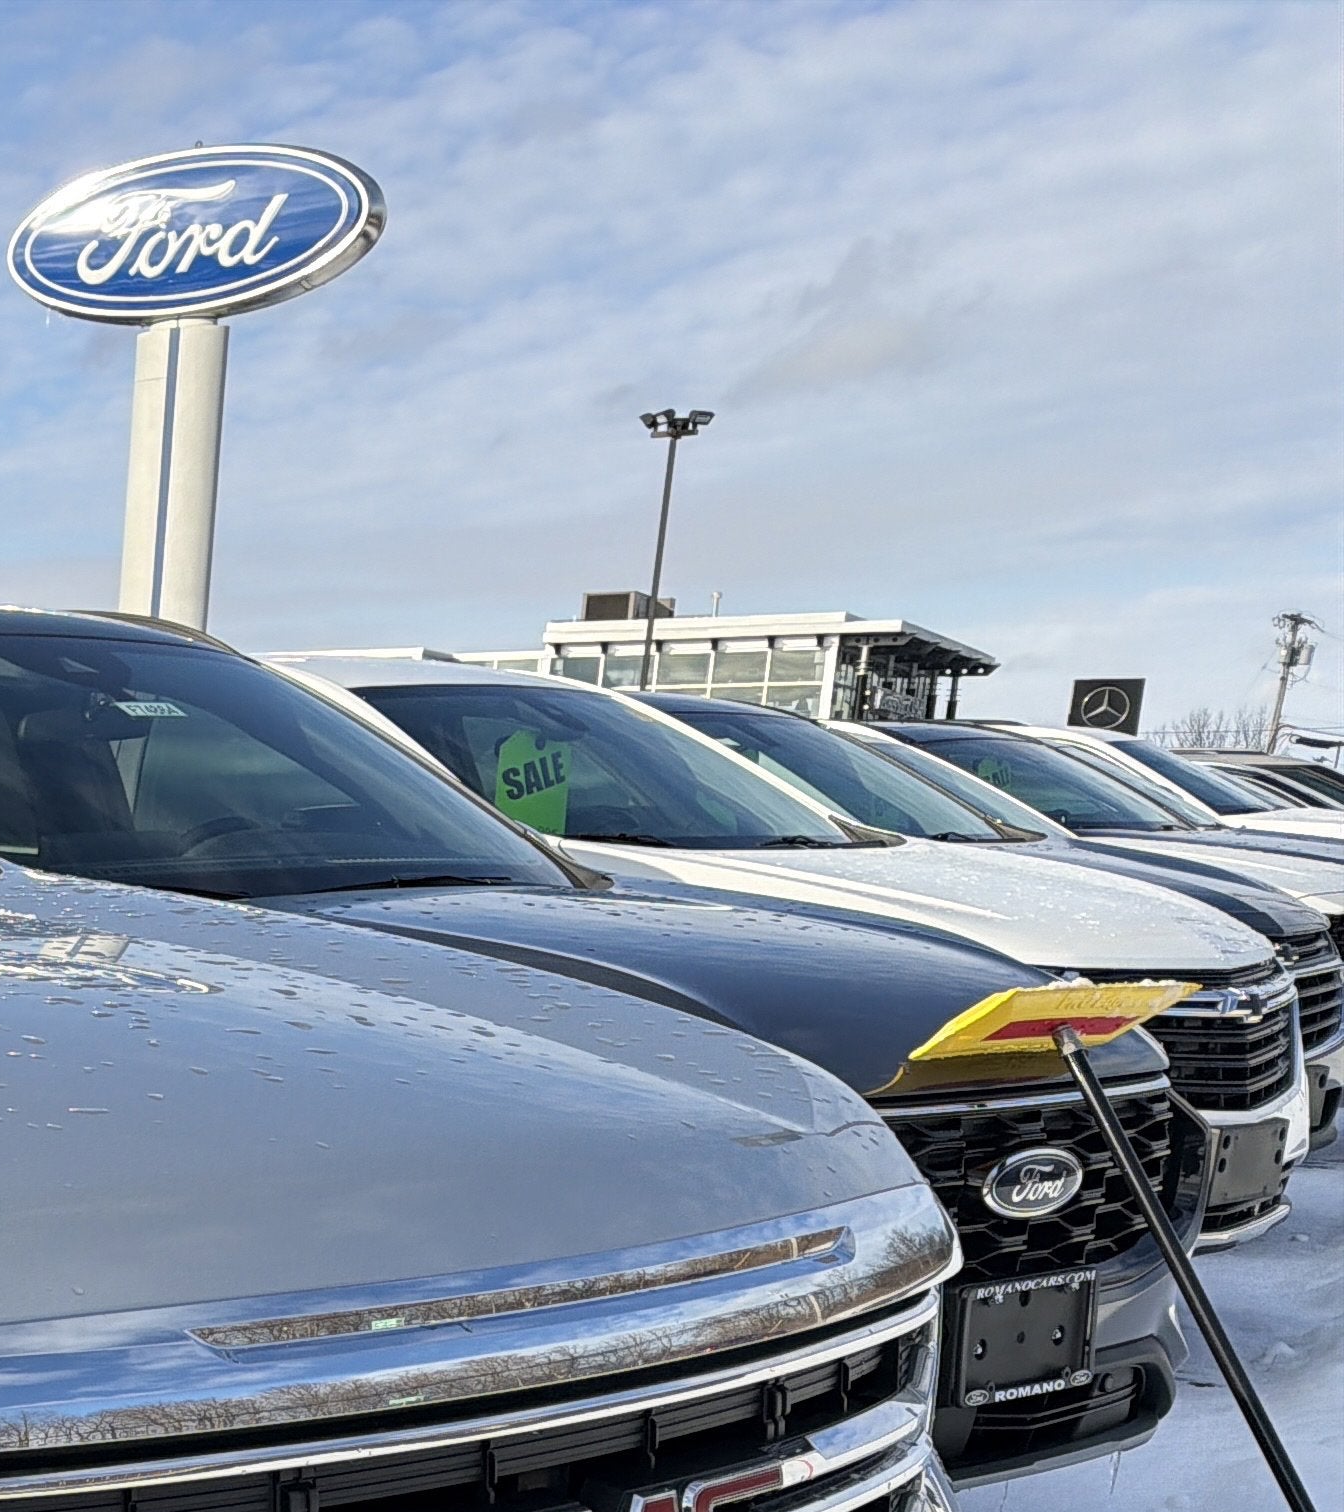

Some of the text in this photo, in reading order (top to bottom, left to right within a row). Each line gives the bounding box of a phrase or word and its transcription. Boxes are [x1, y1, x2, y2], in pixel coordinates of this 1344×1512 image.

[76, 179, 289, 285] Ford
[502, 751, 566, 800] SALE
[1012, 1164, 1066, 1203] Ford
[976, 1269, 1097, 1300] ROMANOCARS.COM
[994, 1379, 1066, 1403] ROMANO
